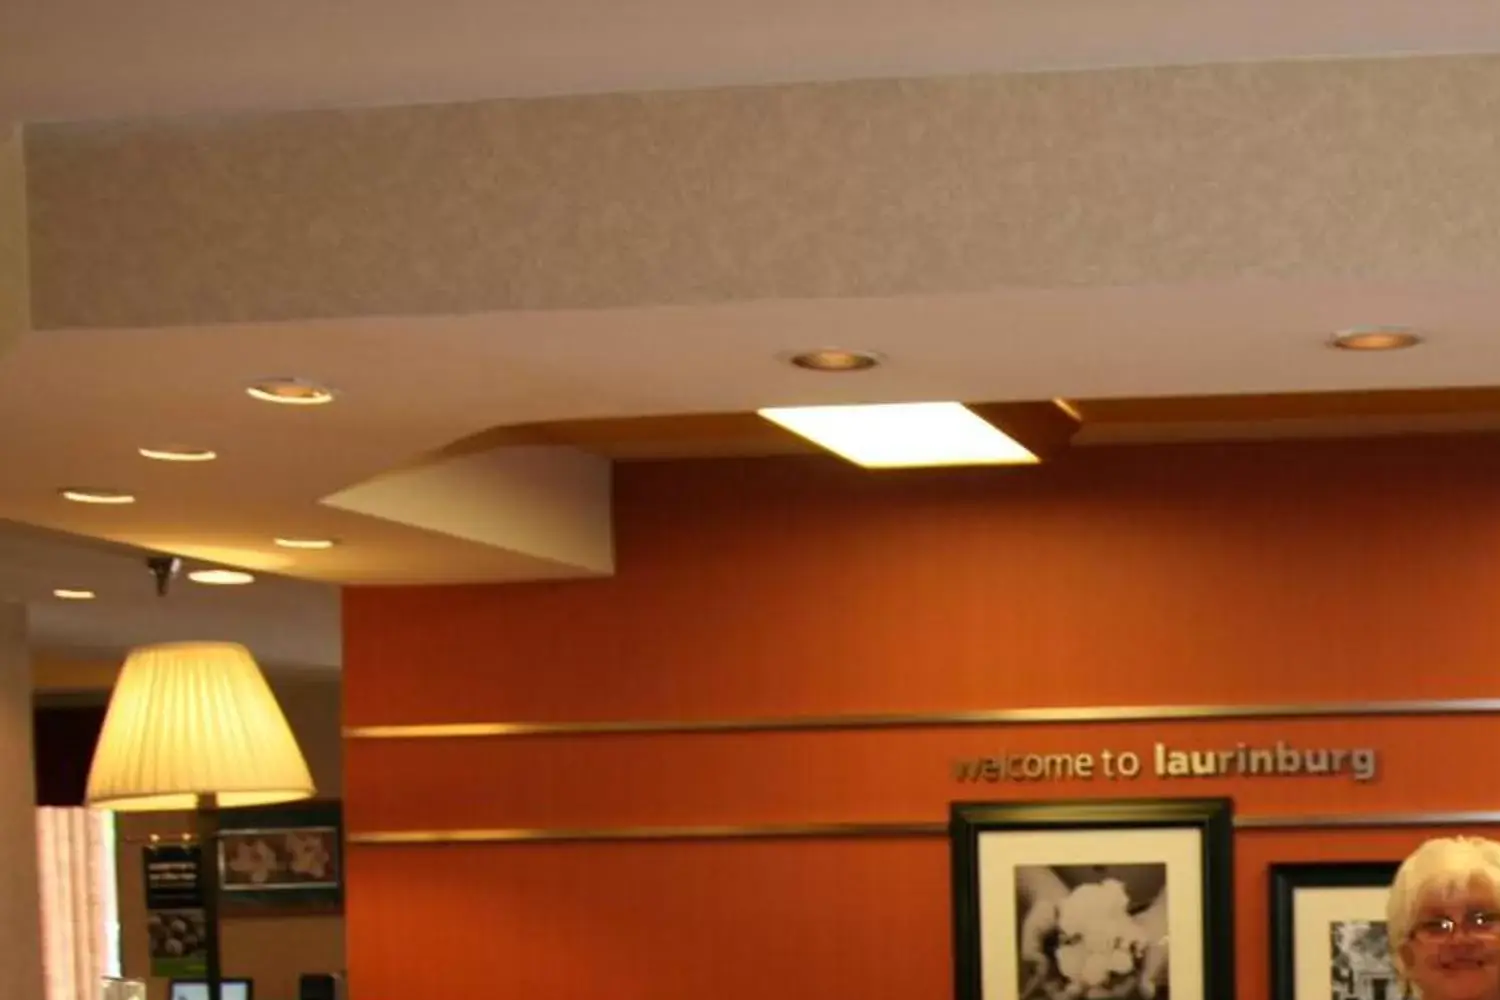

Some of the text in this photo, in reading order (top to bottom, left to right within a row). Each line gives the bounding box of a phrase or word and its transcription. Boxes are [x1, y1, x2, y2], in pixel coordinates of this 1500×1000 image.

[954, 741, 1375, 780] welcome to laurinburg
